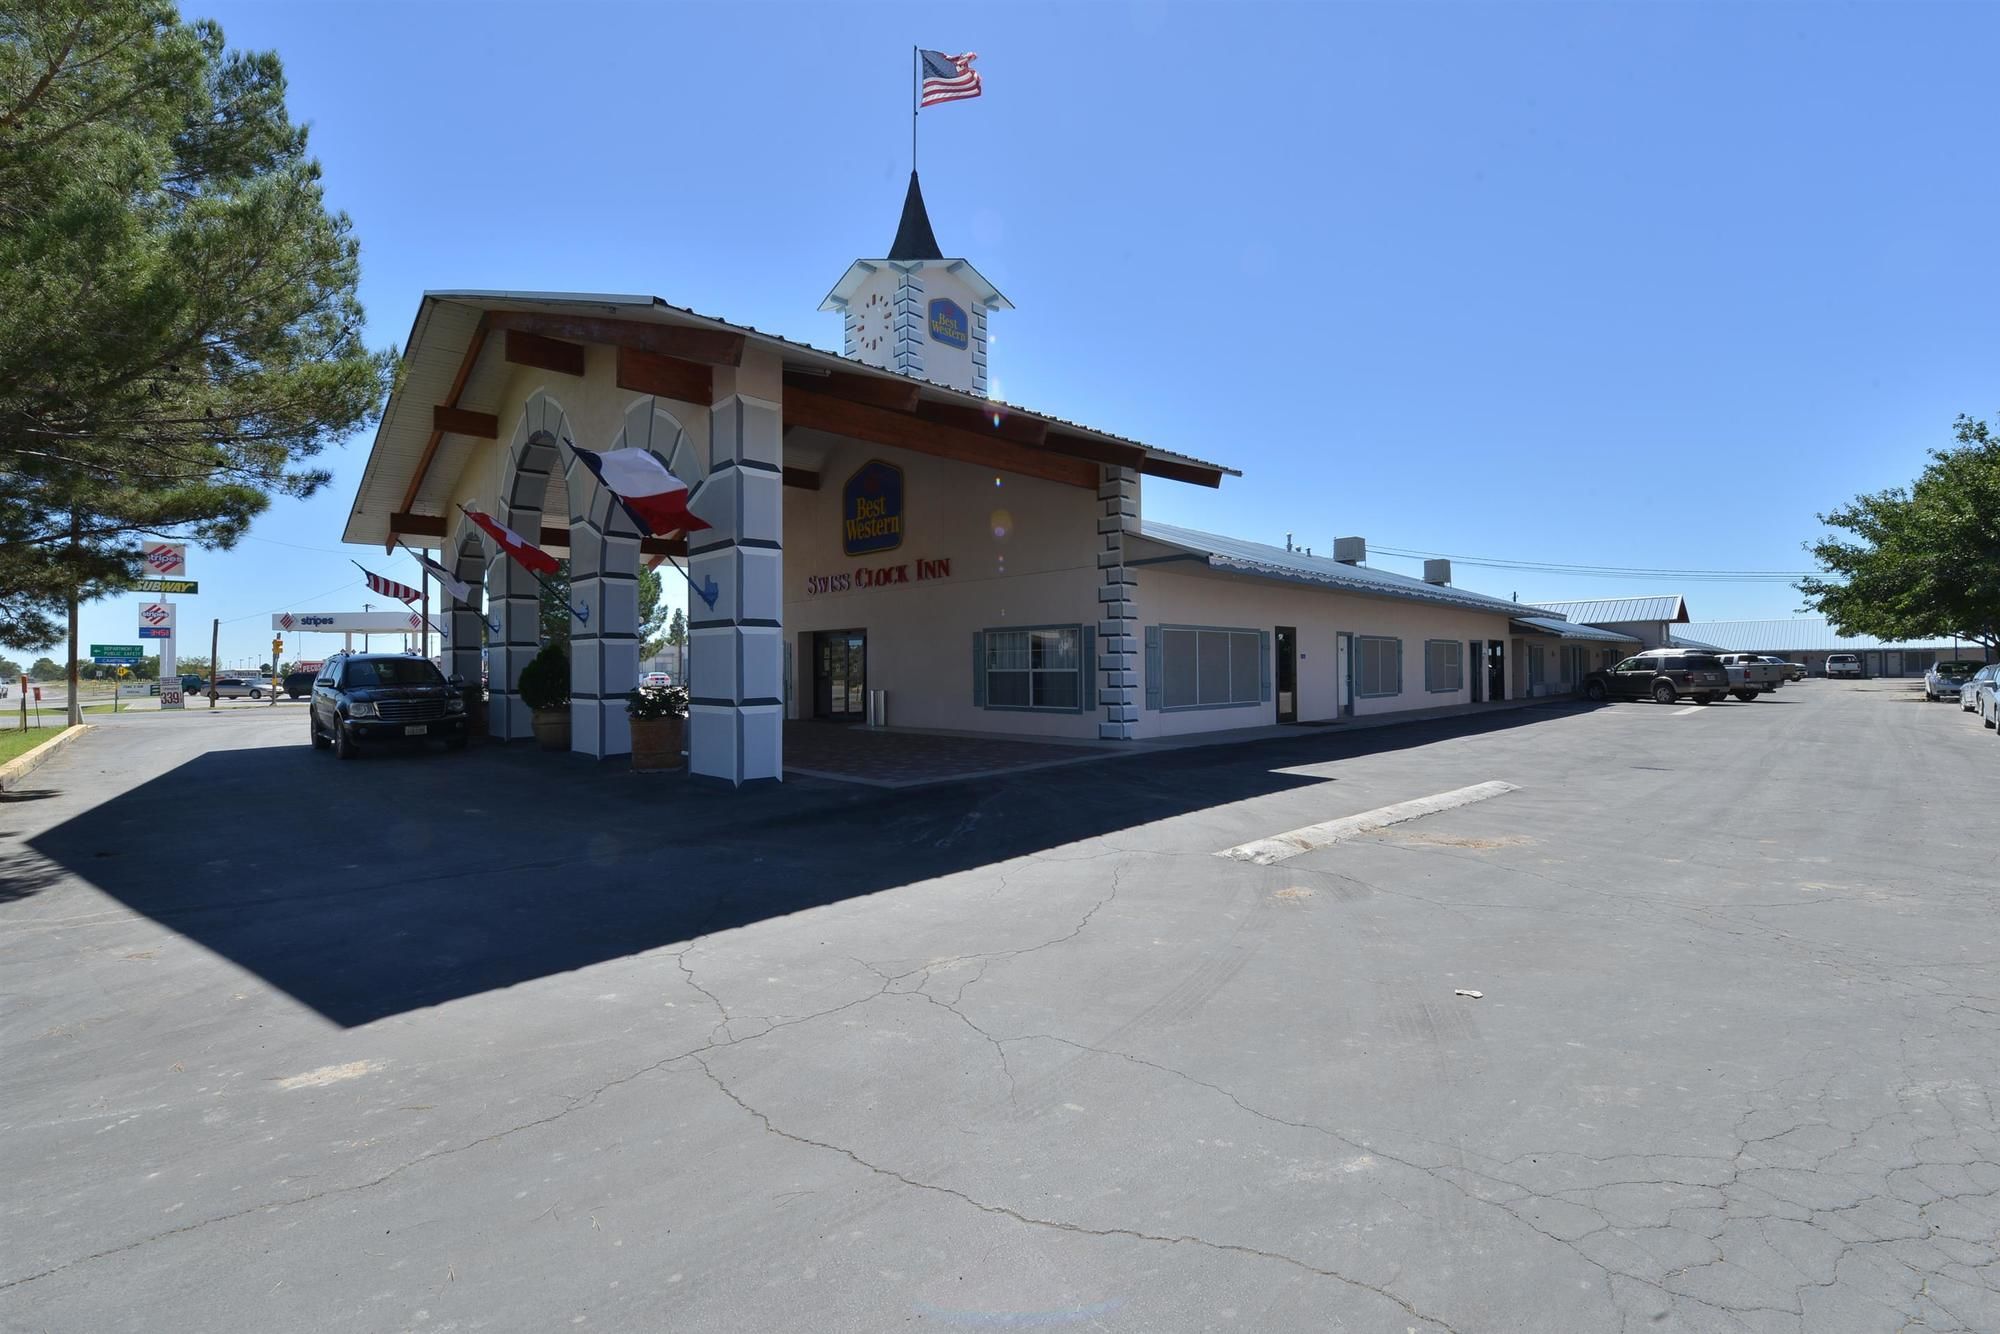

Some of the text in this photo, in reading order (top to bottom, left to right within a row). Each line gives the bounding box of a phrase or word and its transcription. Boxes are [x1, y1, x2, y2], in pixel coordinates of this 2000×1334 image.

[938, 312, 957, 329] Best
[931, 320, 967, 342] Western
[856, 496, 886, 520] Best
[846, 516, 900, 541] Western
[135, 580, 194, 592] SUBWAY
[301, 616, 334, 627] stripes
